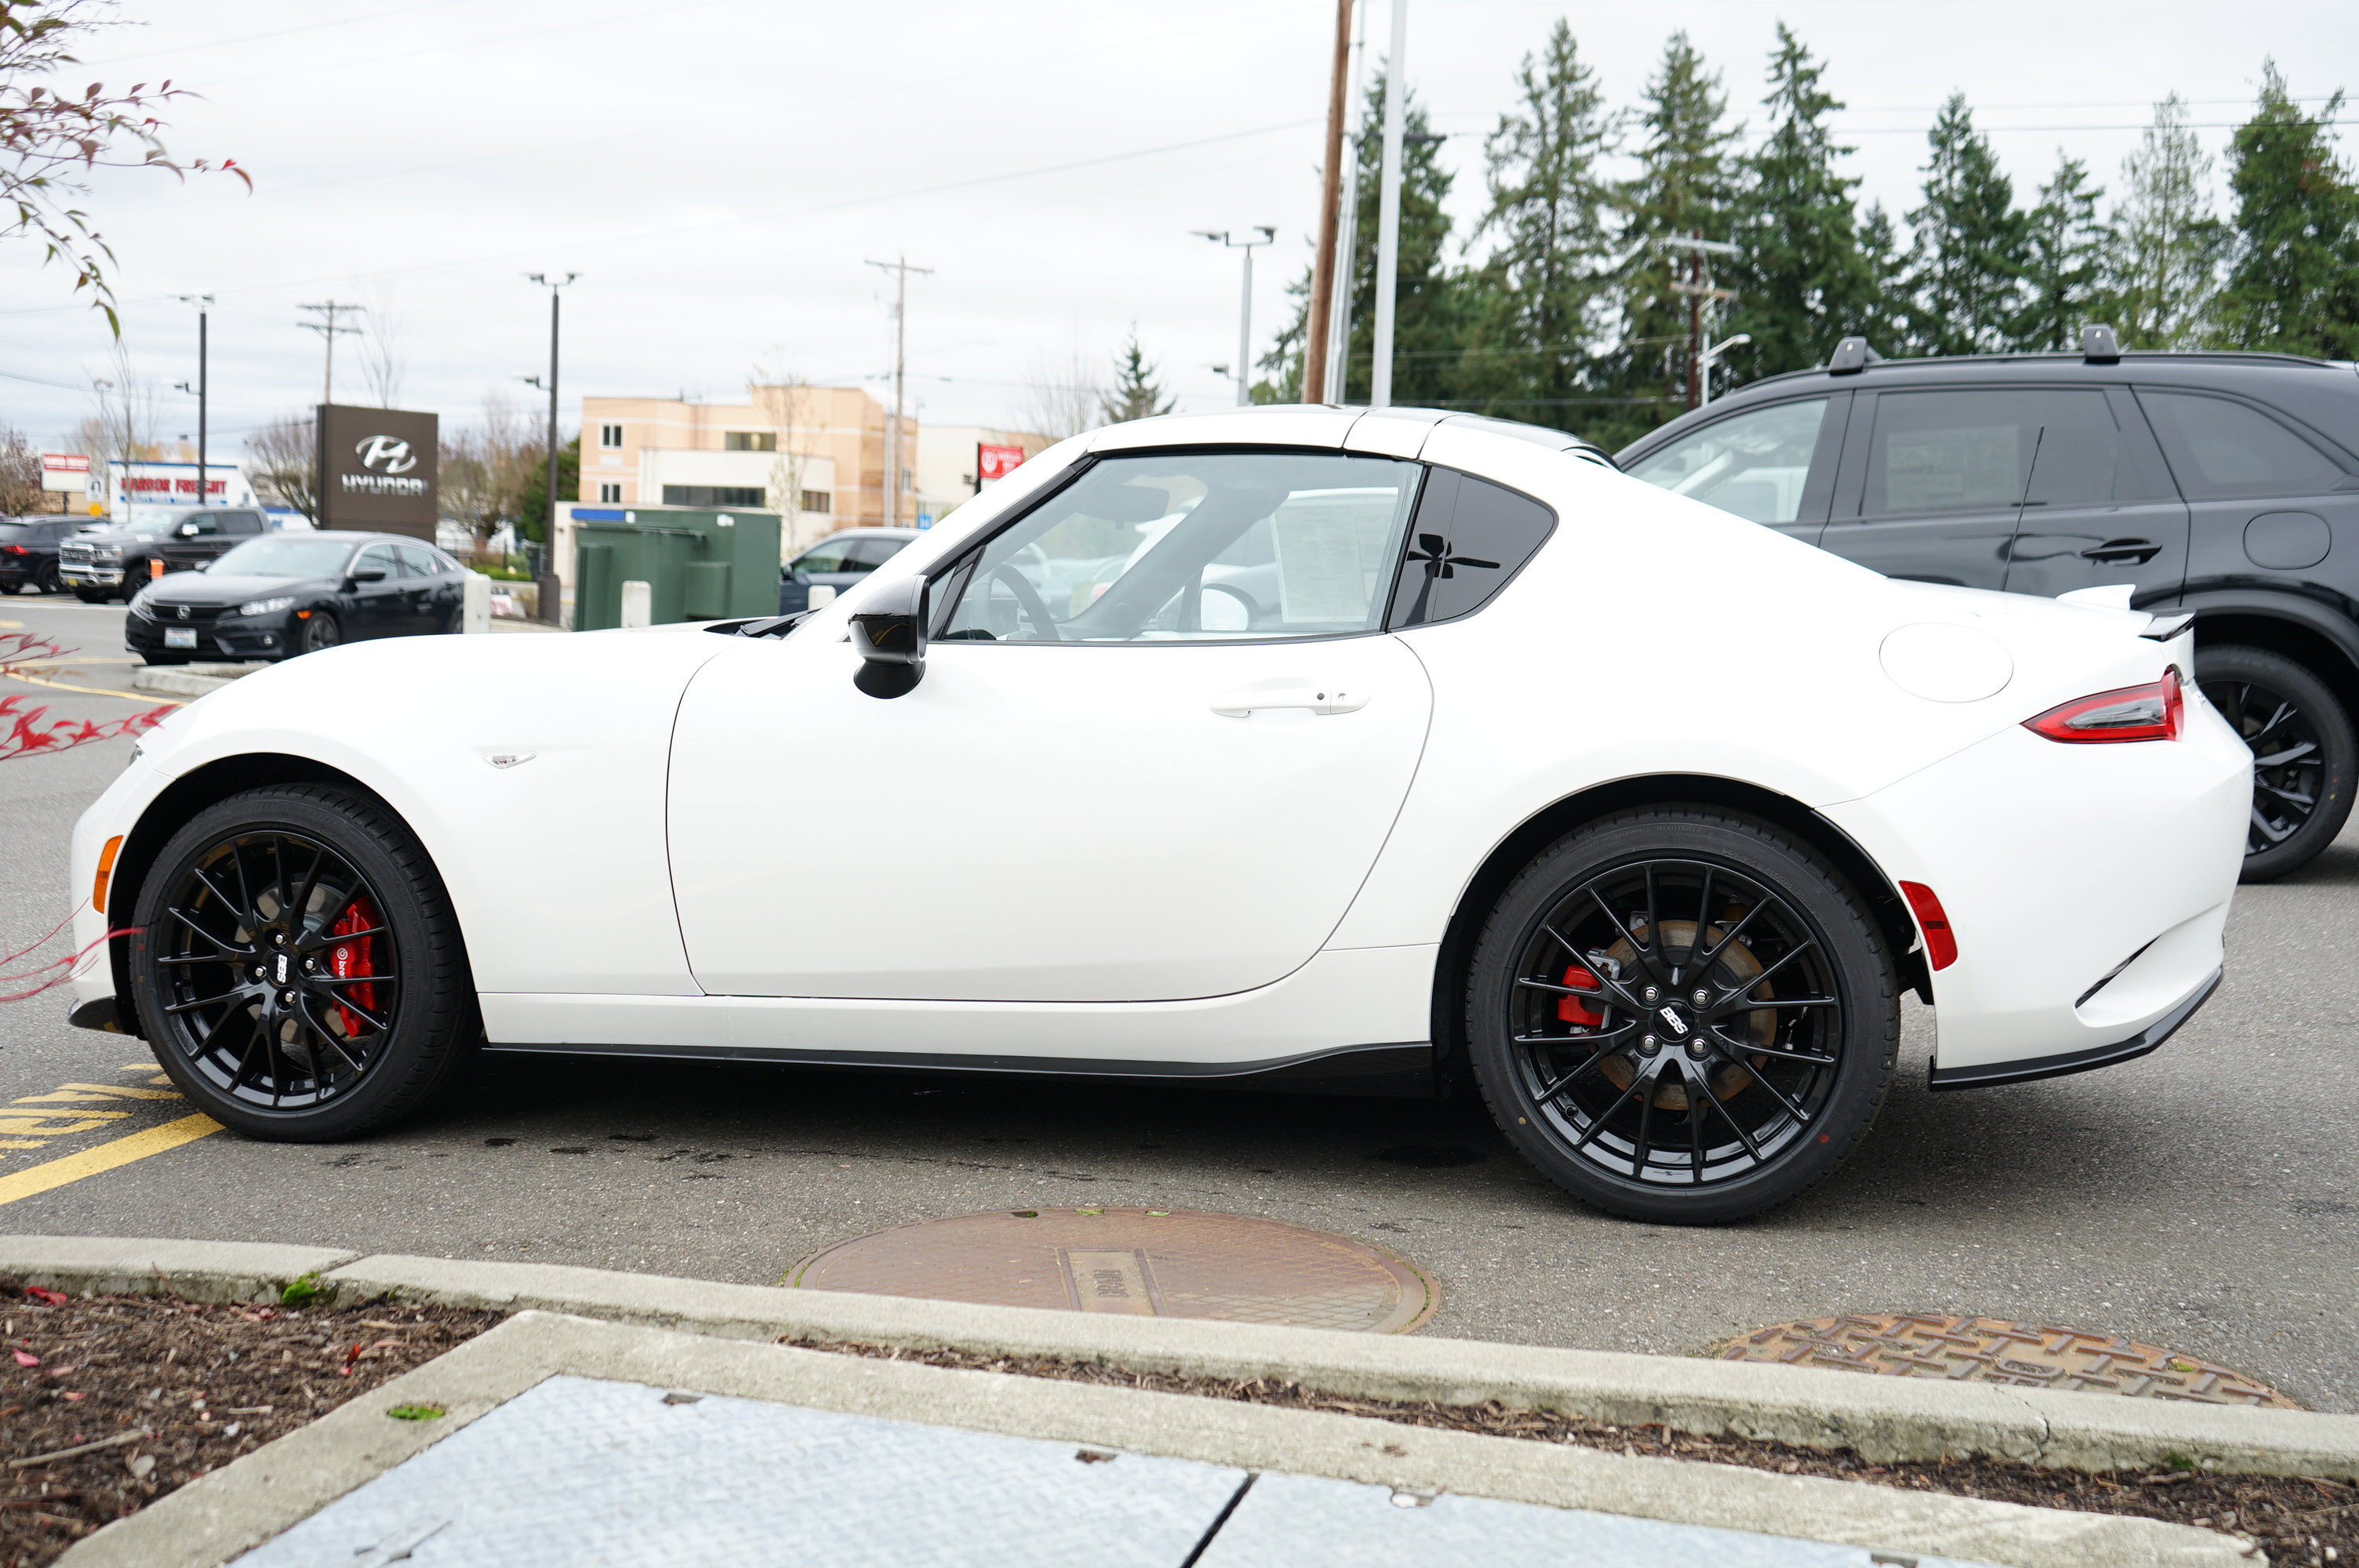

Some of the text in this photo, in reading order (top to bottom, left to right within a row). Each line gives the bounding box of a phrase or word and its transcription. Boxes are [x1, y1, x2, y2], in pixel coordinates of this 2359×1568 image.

[175, 479, 227, 493] FREGHT
[342, 474, 429, 497] HYUNDAI
[277, 953, 288, 983] BBS
[1659, 1006, 1688, 1034] BBS
